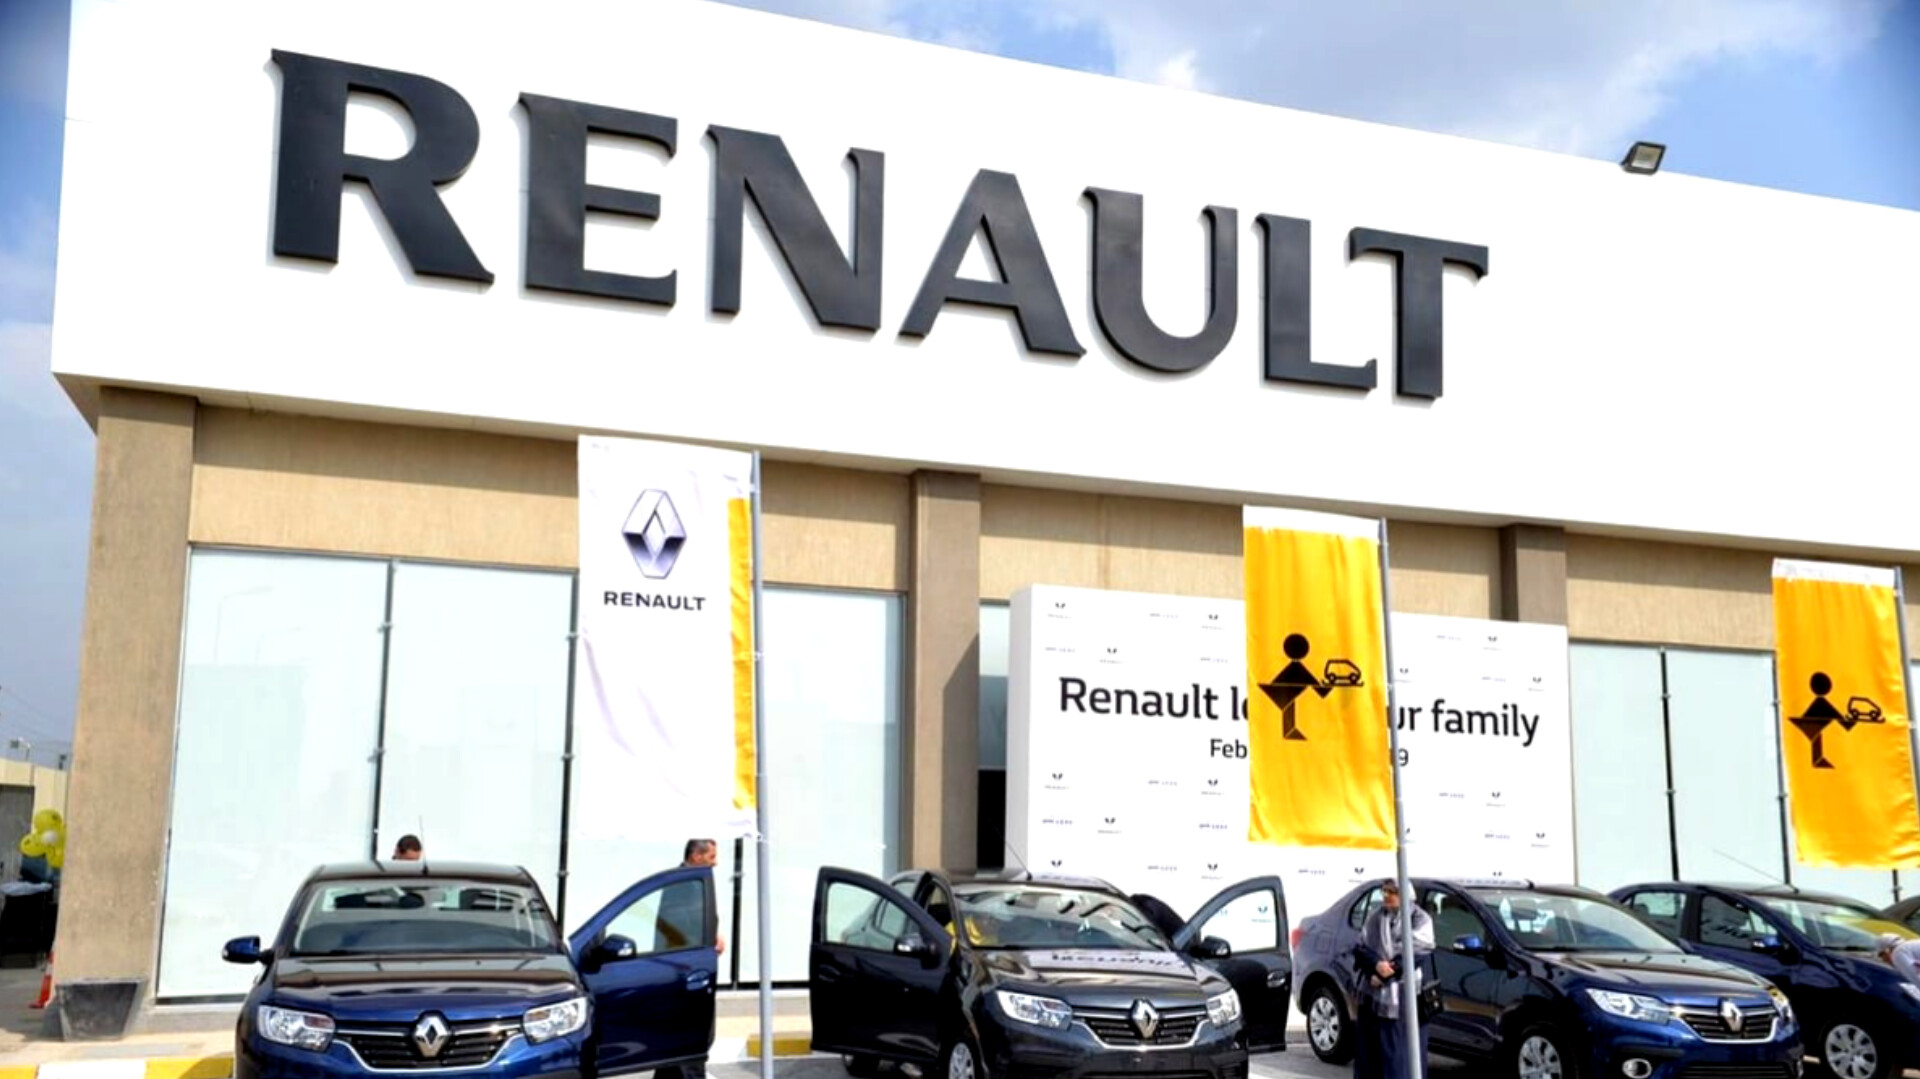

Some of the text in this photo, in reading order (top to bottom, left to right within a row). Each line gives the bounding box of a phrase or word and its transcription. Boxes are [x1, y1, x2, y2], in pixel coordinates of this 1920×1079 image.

[270, 48, 1489, 400] RENAULT
[603, 590, 706, 611] RENAULT
[1059, 676, 1220, 720] Renault
[1430, 698, 1540, 749] family
